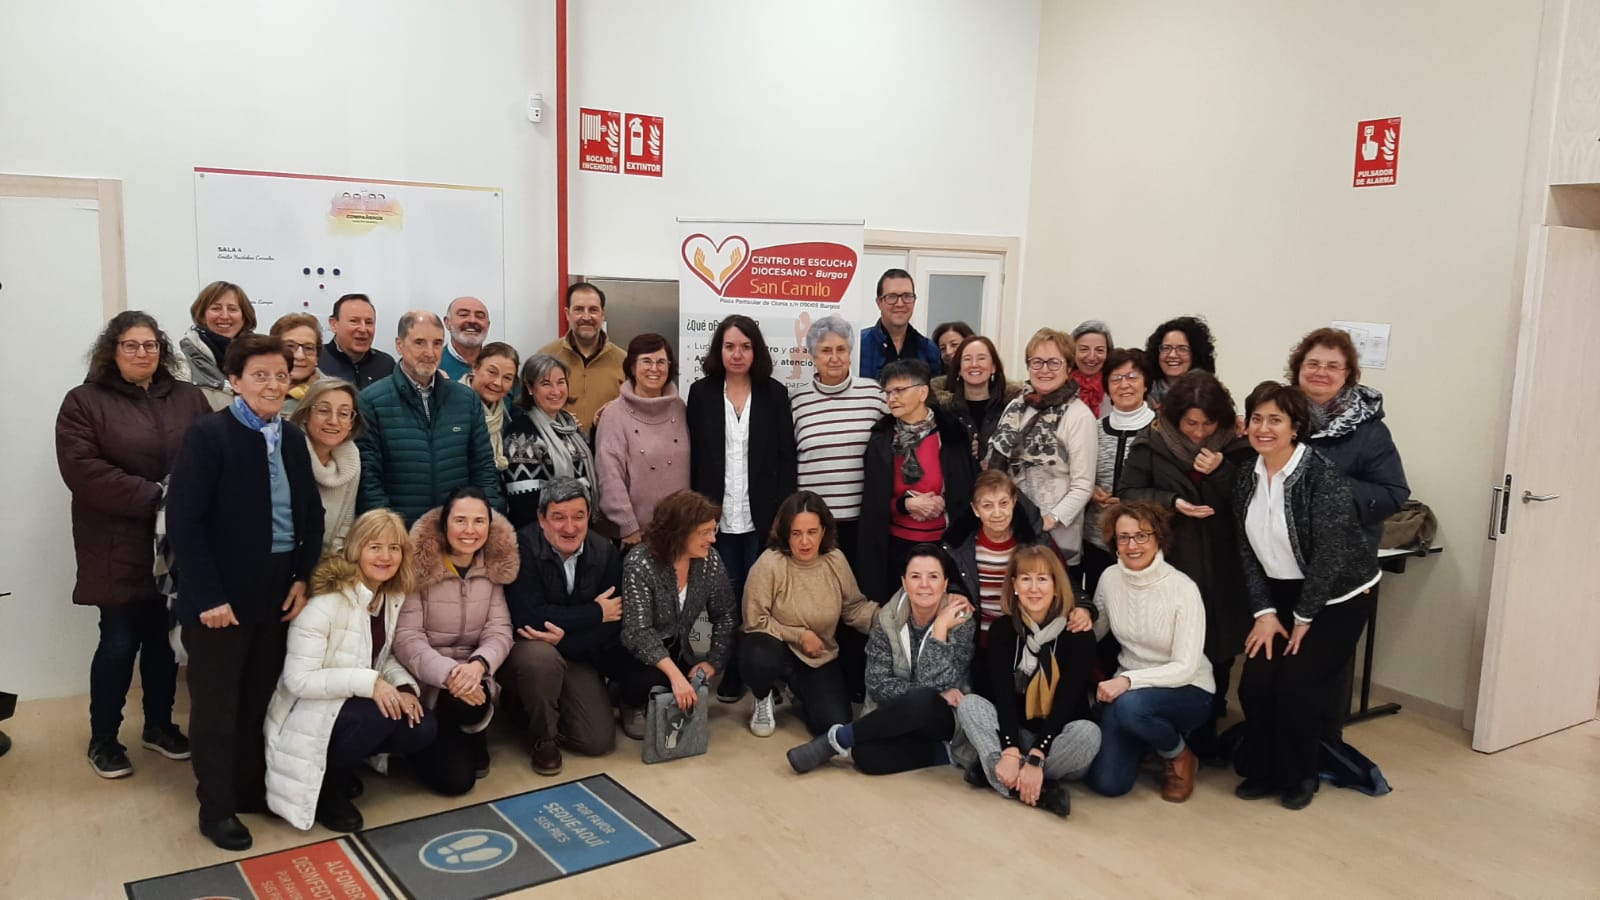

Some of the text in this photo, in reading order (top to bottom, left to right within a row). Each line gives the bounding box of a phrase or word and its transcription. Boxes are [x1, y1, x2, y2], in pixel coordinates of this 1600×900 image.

[586, 154, 604, 163] BOCA
[605, 156, 614, 164] DE
[582, 162, 617, 172] INCENDIOS
[626, 161, 661, 172] EXTINTOR
[1357, 169, 1393, 177] PULSADOR
[1366, 176, 1394, 184] ALARMA
[751, 255, 853, 268] CENTRO DE ESCUCHA
[751, 267, 807, 277] DIOCESANO
[815, 269, 848, 280] Burgos
[750, 278, 831, 297] San Camilo
[686, 318, 706, 332] ¿Qué
[694, 342, 711, 351] Lug
[543, 802, 610, 847] SEQUE AQUÍ
[572, 802, 616, 834] POR FAVOR
[291, 856, 336, 900] DESINFECT
[325, 860, 367, 900] ALFOMBR
